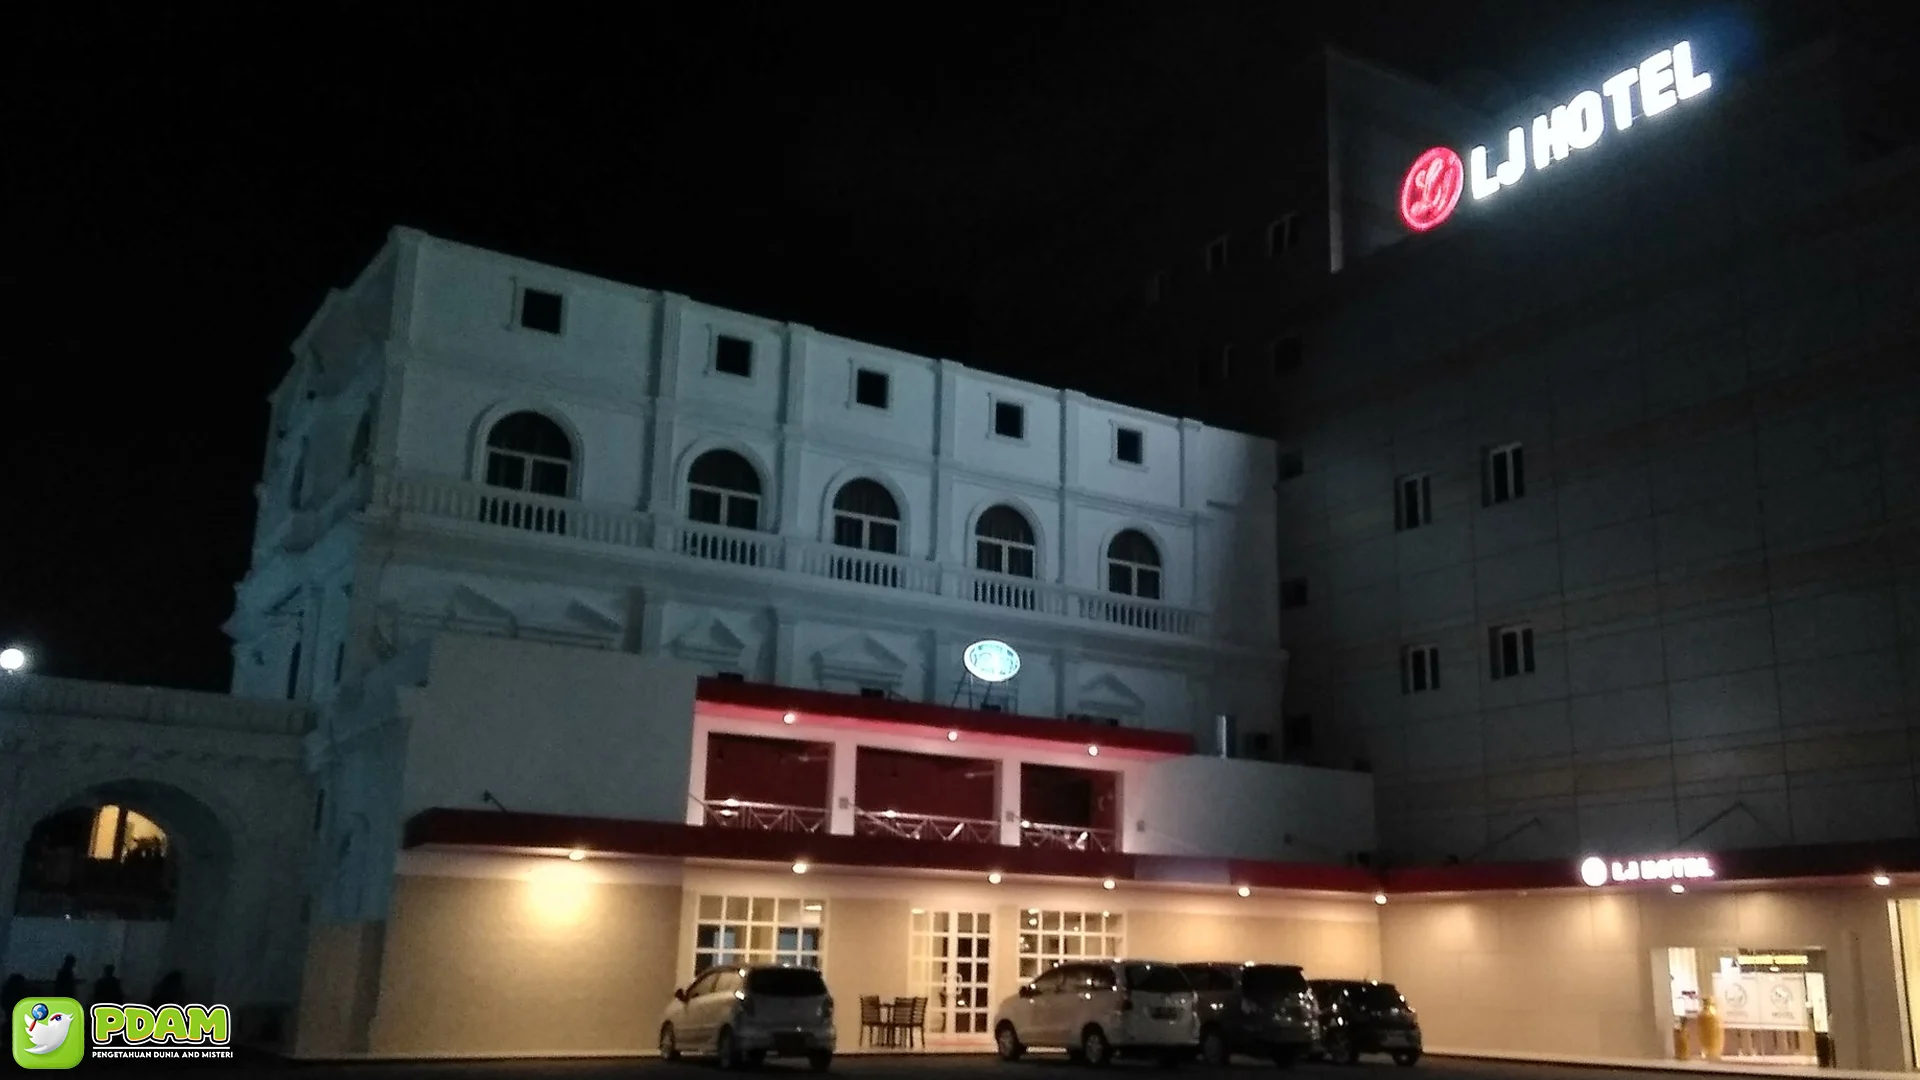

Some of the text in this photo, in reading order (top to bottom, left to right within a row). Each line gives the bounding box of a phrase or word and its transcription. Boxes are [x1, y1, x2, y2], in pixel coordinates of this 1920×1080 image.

[1470, 40, 1713, 200] LJ HOTEL
[1611, 861, 1640, 882] LJ
